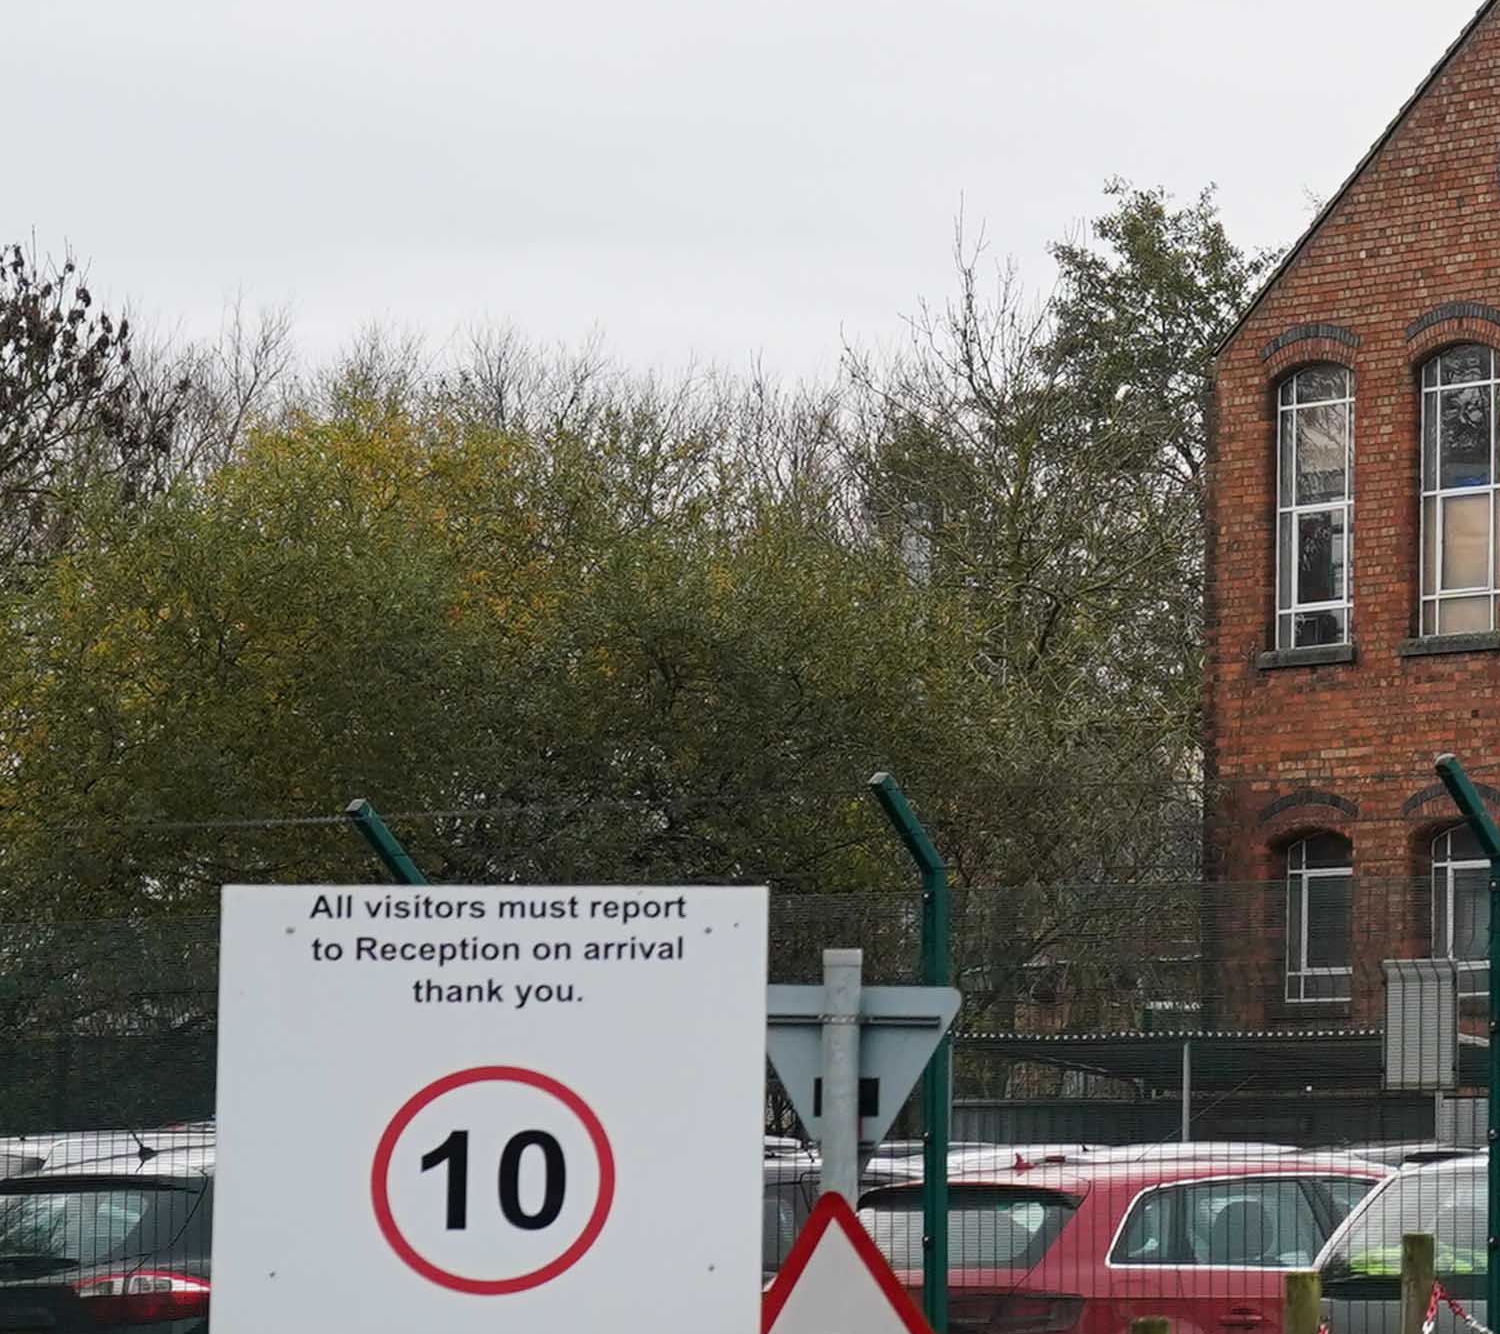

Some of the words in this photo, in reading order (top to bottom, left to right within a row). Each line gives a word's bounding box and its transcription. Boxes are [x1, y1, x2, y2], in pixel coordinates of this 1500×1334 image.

[309, 894, 353, 919] All
[364, 894, 486, 919] visitors
[498, 896, 579, 919] must
[590, 896, 686, 925] report
[311, 938, 344, 962] to
[355, 936, 520, 967] Reception
[532, 942, 572, 961] on
[583, 935, 684, 961] arrival
[412, 978, 503, 1004] thank
[515, 984, 583, 1009] you.
[421, 1129, 567, 1231] 10
